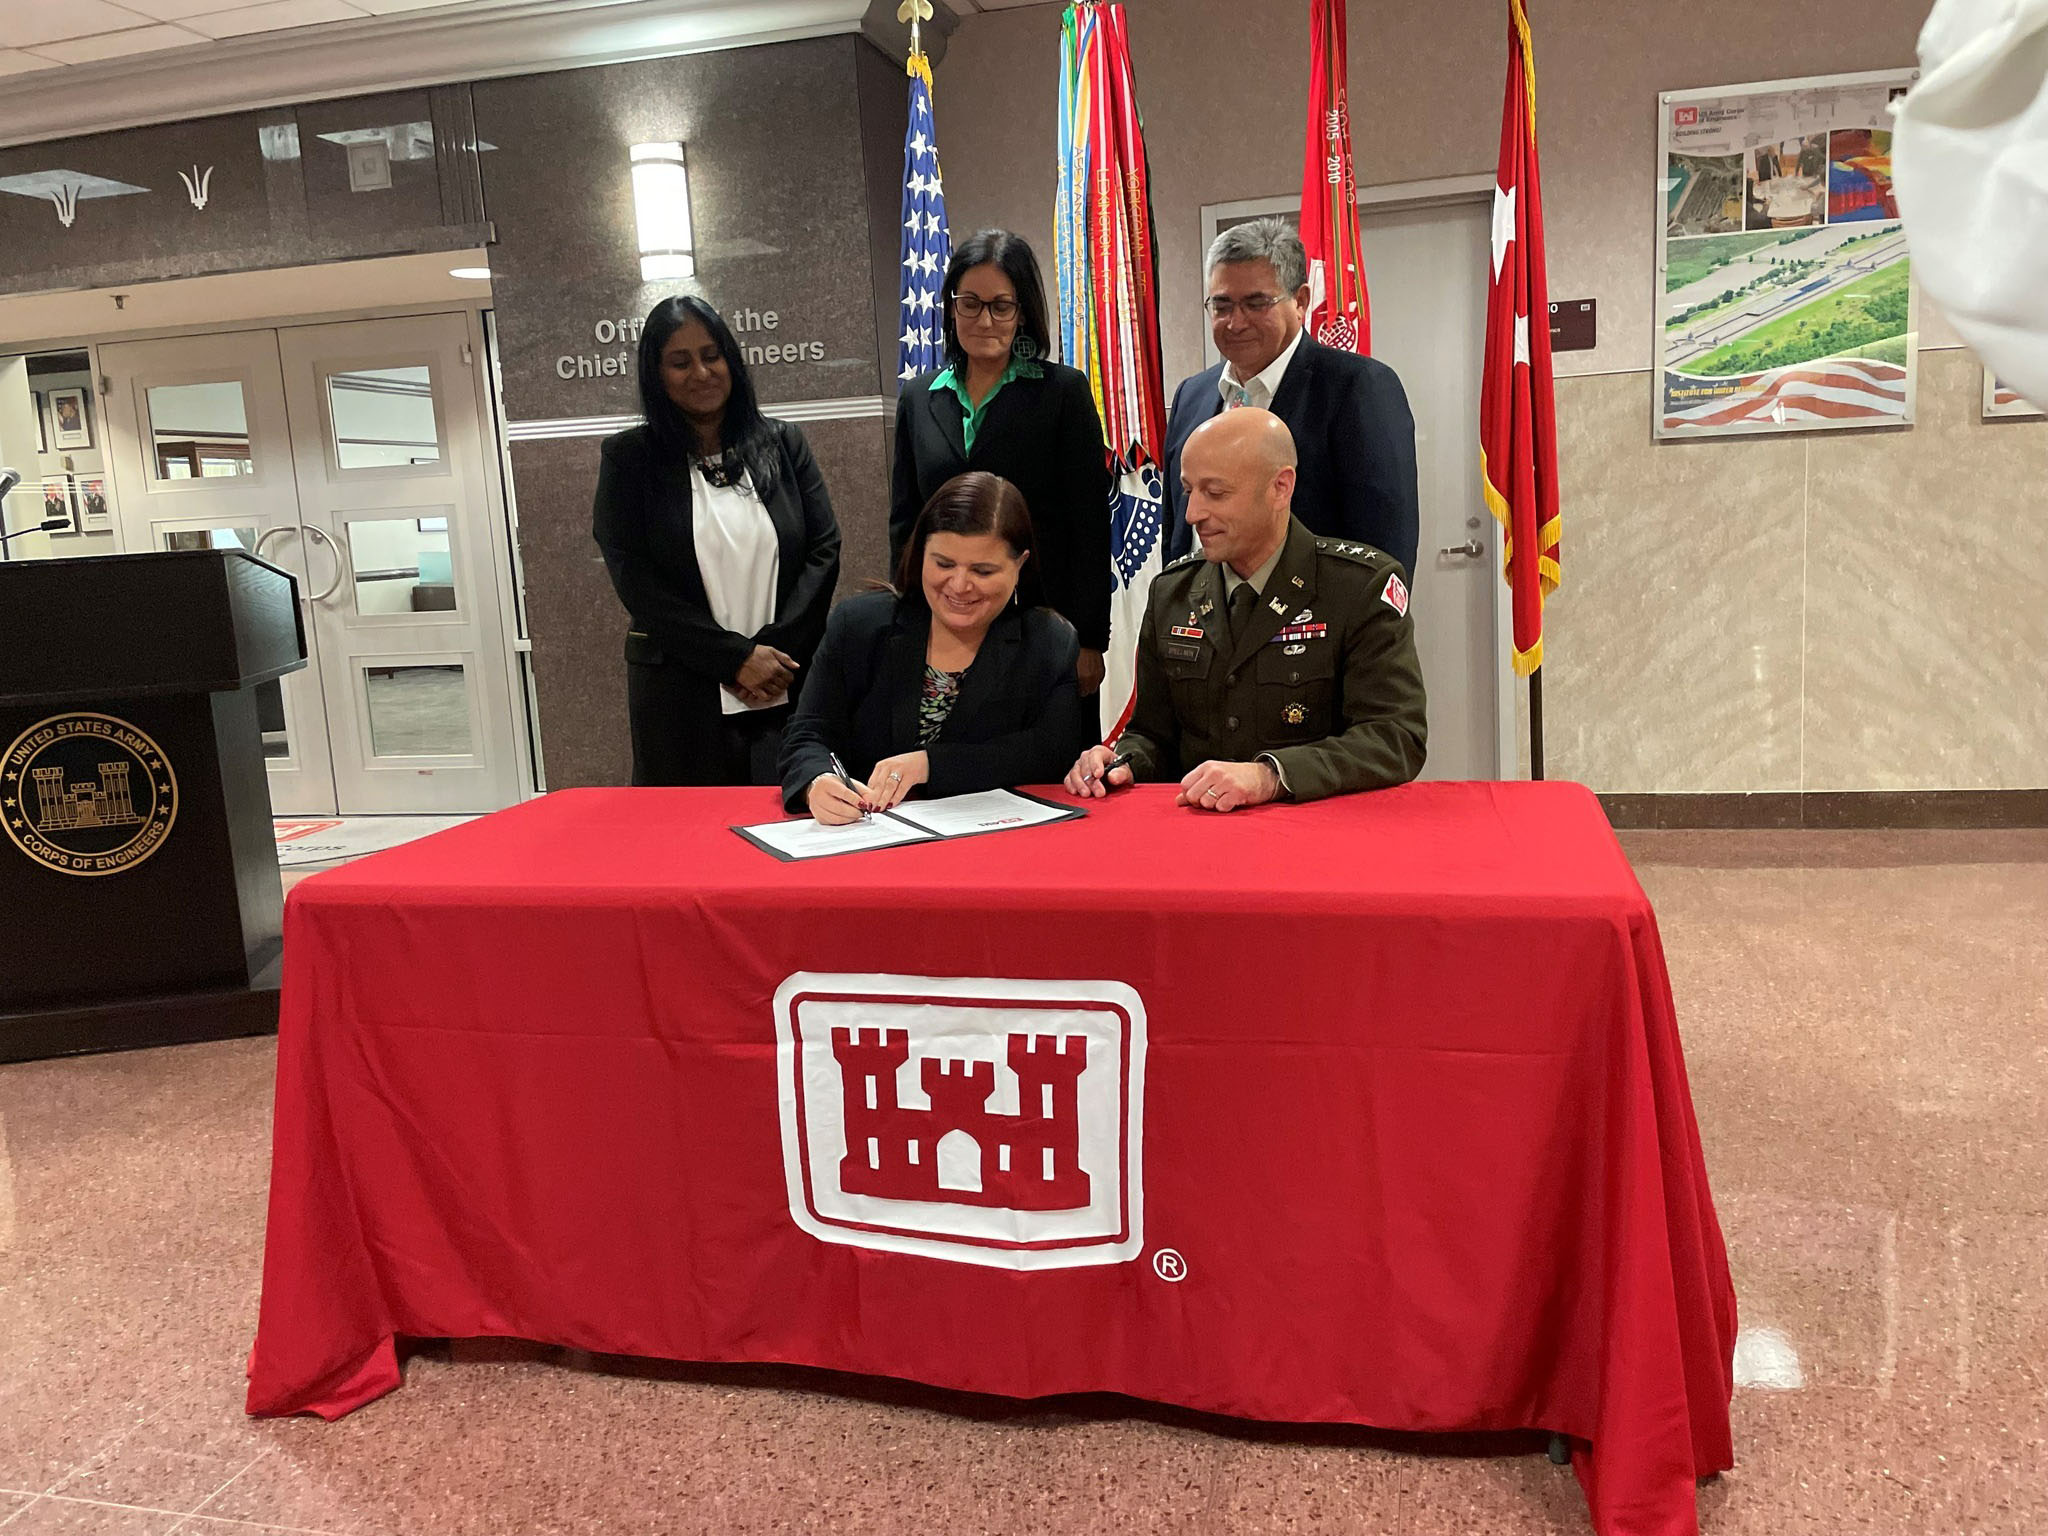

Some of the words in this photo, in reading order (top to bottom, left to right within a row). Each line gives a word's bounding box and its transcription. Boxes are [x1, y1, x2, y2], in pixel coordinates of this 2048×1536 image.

[1326, 110, 1340, 140] 2005
[1327, 155, 1341, 184] 2010
[1096, 168, 1112, 256] LEXINGTON
[1126, 168, 1145, 256] YORKTOWN
[595, 317, 645, 344] Offi
[733, 308, 779, 332] the
[556, 352, 627, 379] Chief
[741, 341, 825, 366] ineers
[10, 728, 54, 765] UNITED
[56, 720, 113, 735] STATES
[114, 729, 154, 756] ARMY
[23, 834, 69, 866] CORPS
[72, 858, 92, 869] OF
[95, 821, 165, 869] ENGINEERS
